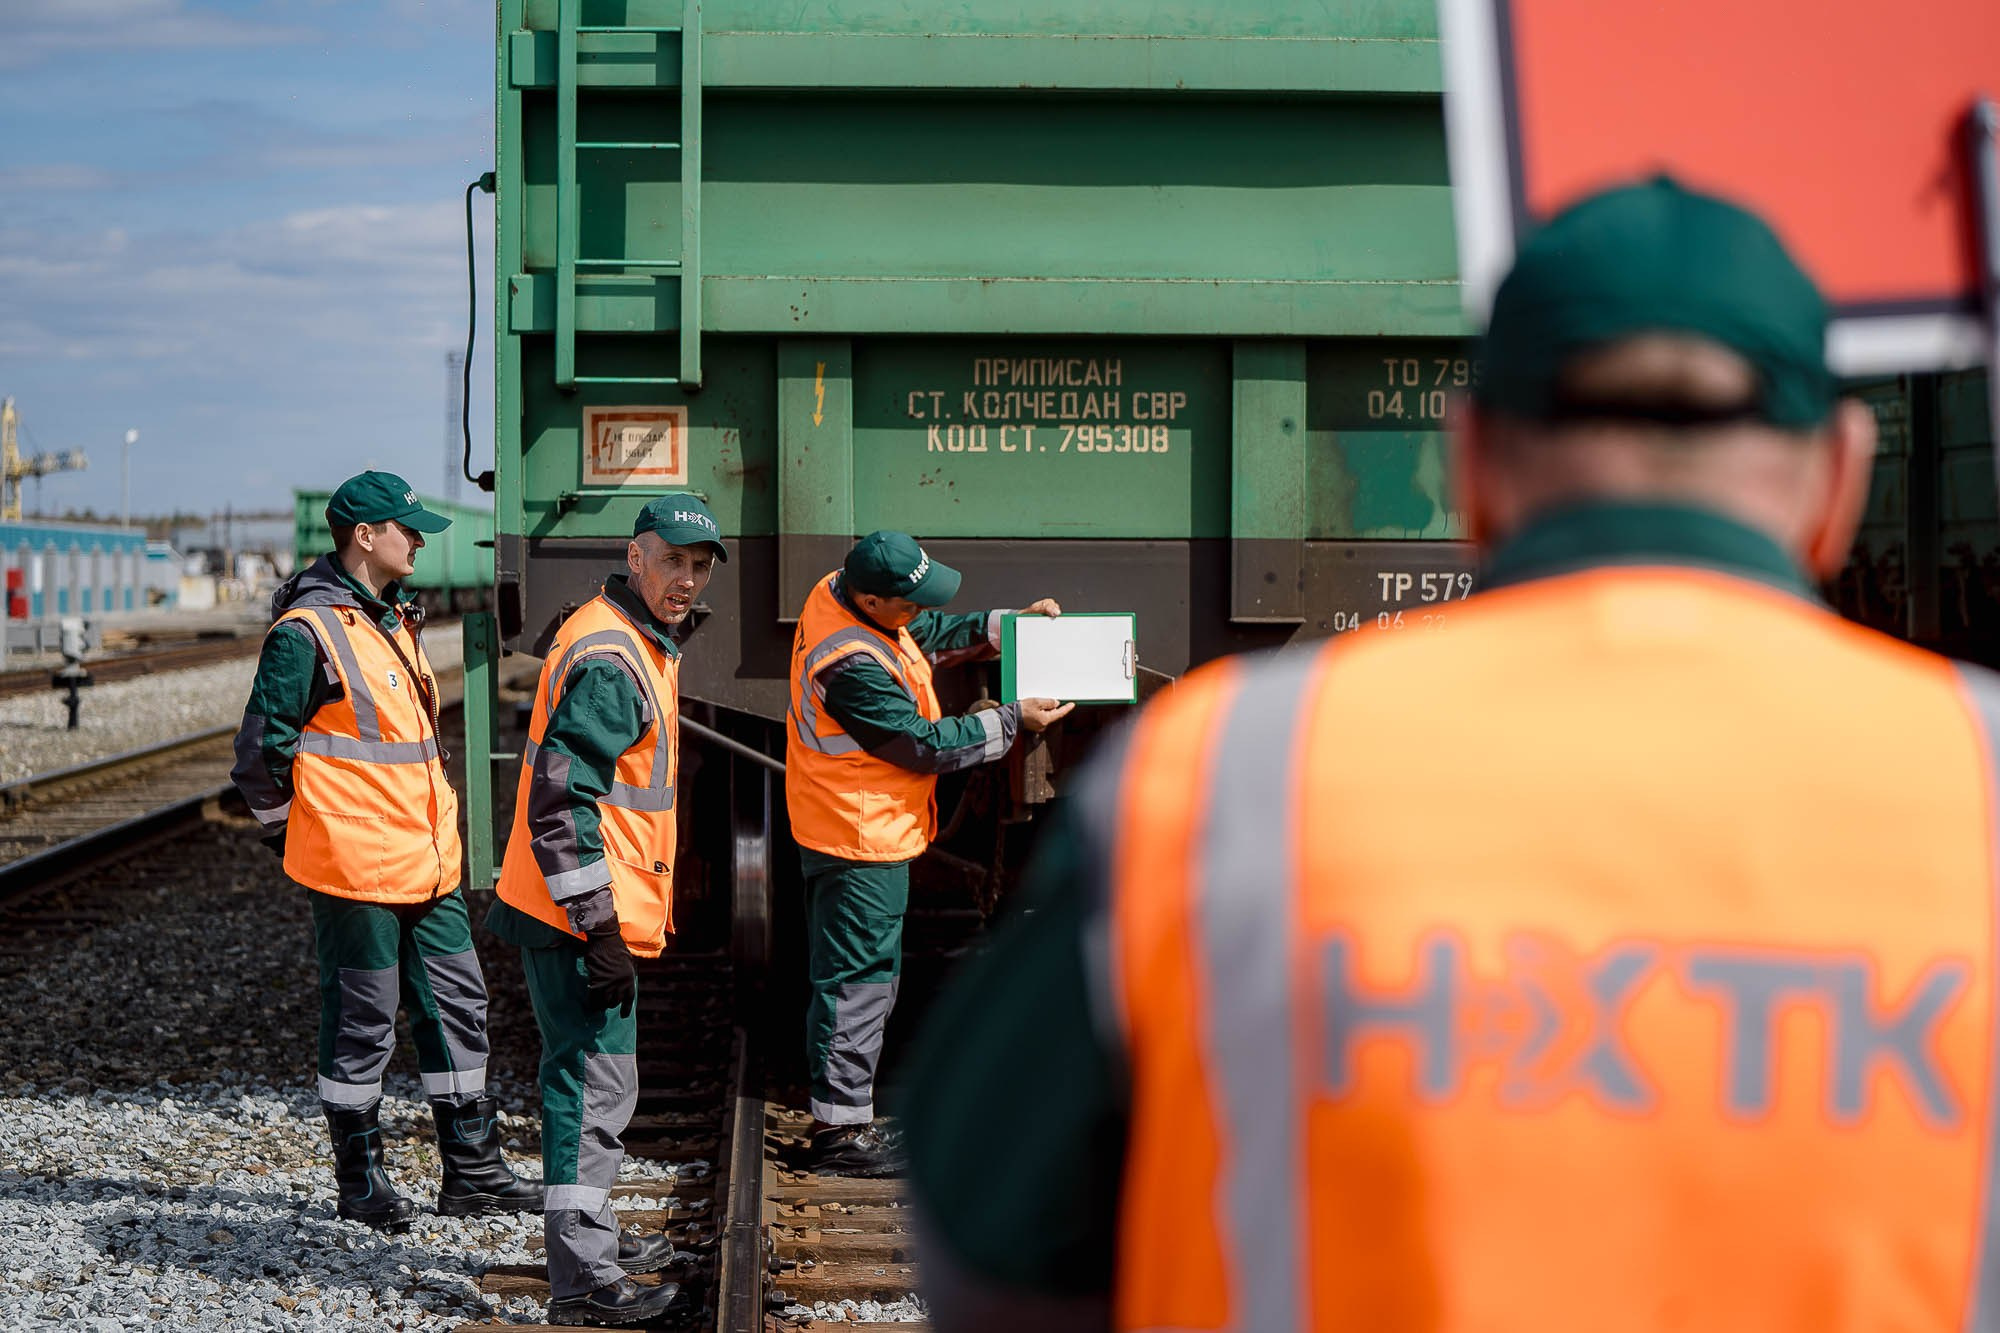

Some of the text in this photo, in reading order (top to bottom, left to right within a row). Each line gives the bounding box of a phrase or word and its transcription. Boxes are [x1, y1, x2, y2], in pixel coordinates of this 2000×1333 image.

[973, 358, 1122, 386] ПРИПИСАН
[907, 391, 1187, 419] СТ. КОЛЧЕДАН СВР
[927, 424, 1169, 453] КОД СТ. 795308
[1420, 572, 1473, 601] 579
[1333, 611, 1361, 632] 04
